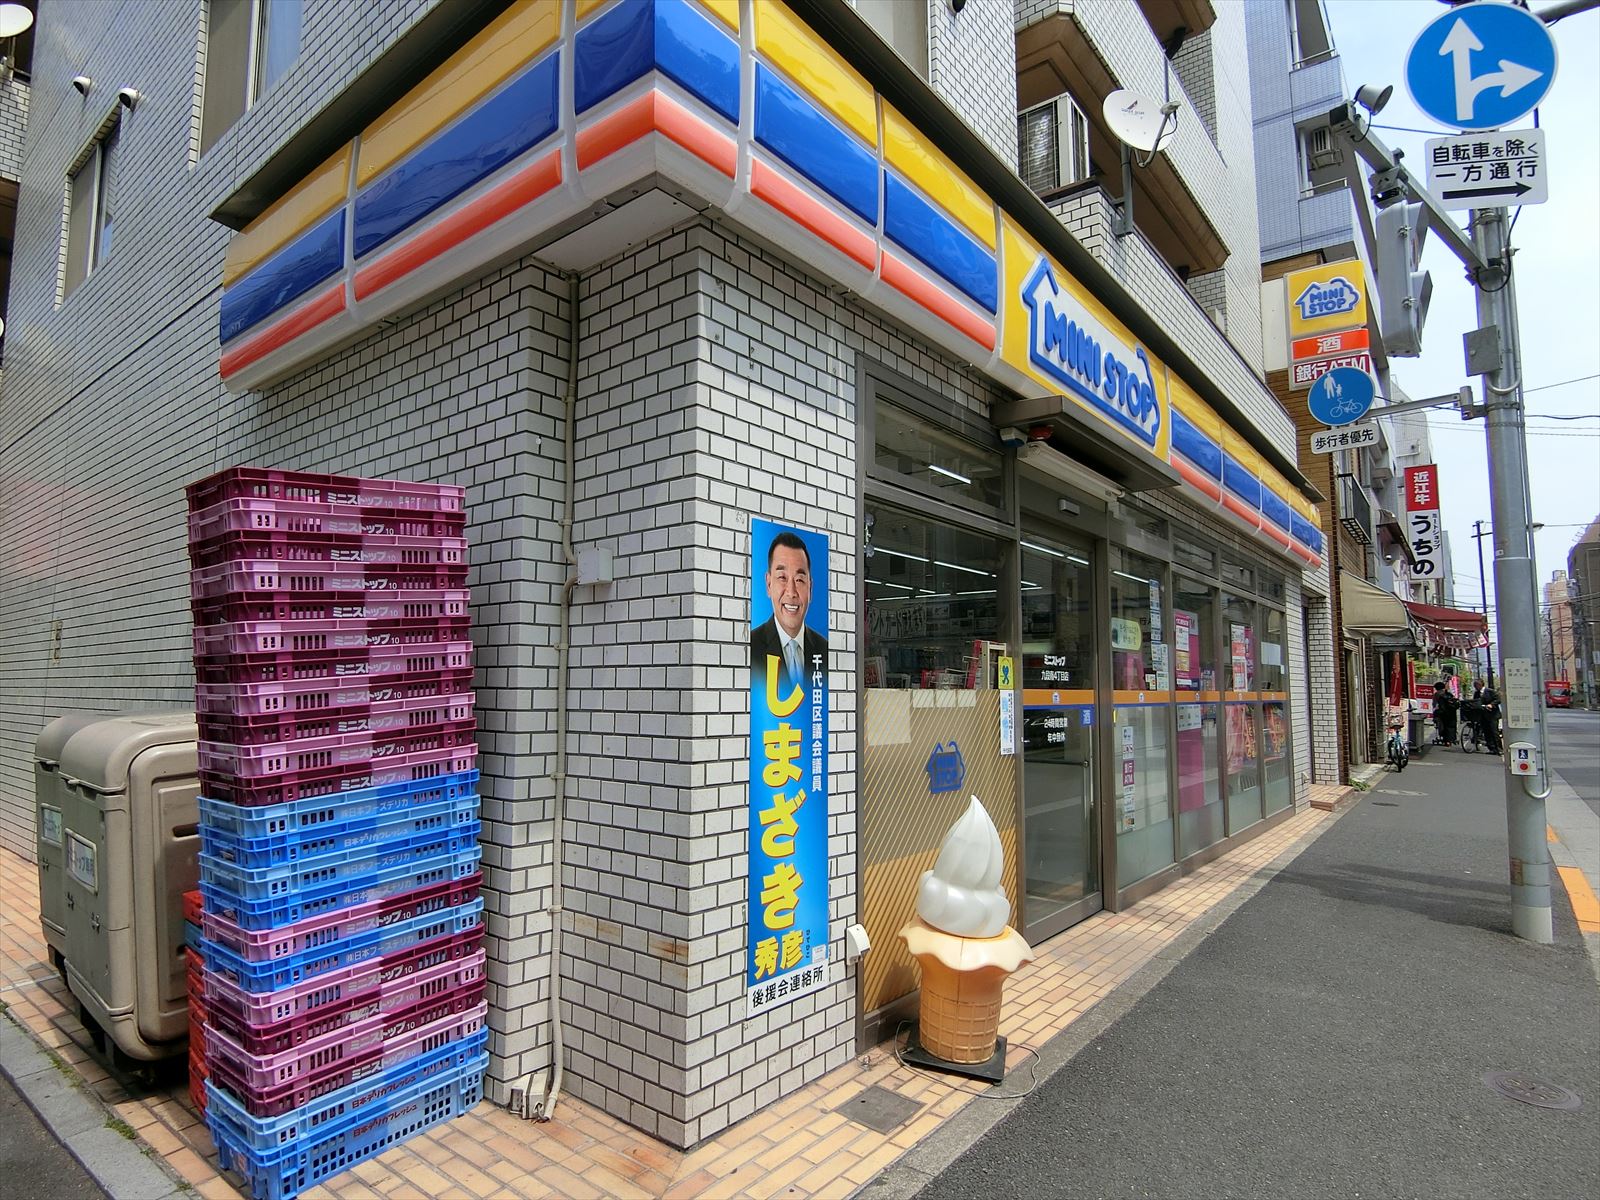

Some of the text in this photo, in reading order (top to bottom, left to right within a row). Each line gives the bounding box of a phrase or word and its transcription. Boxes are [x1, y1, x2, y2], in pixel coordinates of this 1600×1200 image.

[1432, 139, 1538, 163] 自転車を除く
[1435, 160, 1538, 183] 一方通行
[1309, 287, 1345, 303] MINI
[1309, 298, 1347, 315] STOP
[1317, 335, 1342, 354] 酒
[1044, 300, 1152, 424] MINI STOP
[1315, 428, 1375, 450] 歩行者優先
[1413, 471, 1430, 505] 近江牛
[327, 492, 382, 505] ミニストップ
[329, 521, 385, 534] ミニストップ
[330, 549, 387, 561] ミニストップ
[1411, 515, 1435, 576] うちの
[332, 578, 388, 590] ミニストップ
[333, 606, 389, 618] ミニストップ
[335, 633, 391, 646] ミニストップ
[336, 661, 391, 675] ミニストップ
[337, 688, 393, 704] ミニストップ
[338, 716, 394, 732] ミニストップ
[812, 654, 823, 793] 千代田区議会議員
[339, 743, 395, 761] ミニストップ
[341, 772, 396, 790] ミニストップ
[758, 653, 807, 931] しまざき
[346, 910, 403, 934] ミニストップ
[754, 929, 804, 981] 秀彦
[348, 964, 404, 992] ミニストップ
[752, 965, 824, 1008] 後援会連絡所
[351, 1021, 407, 1050] ミニストップ
[351, 1050, 406, 1080] ミニストップ
